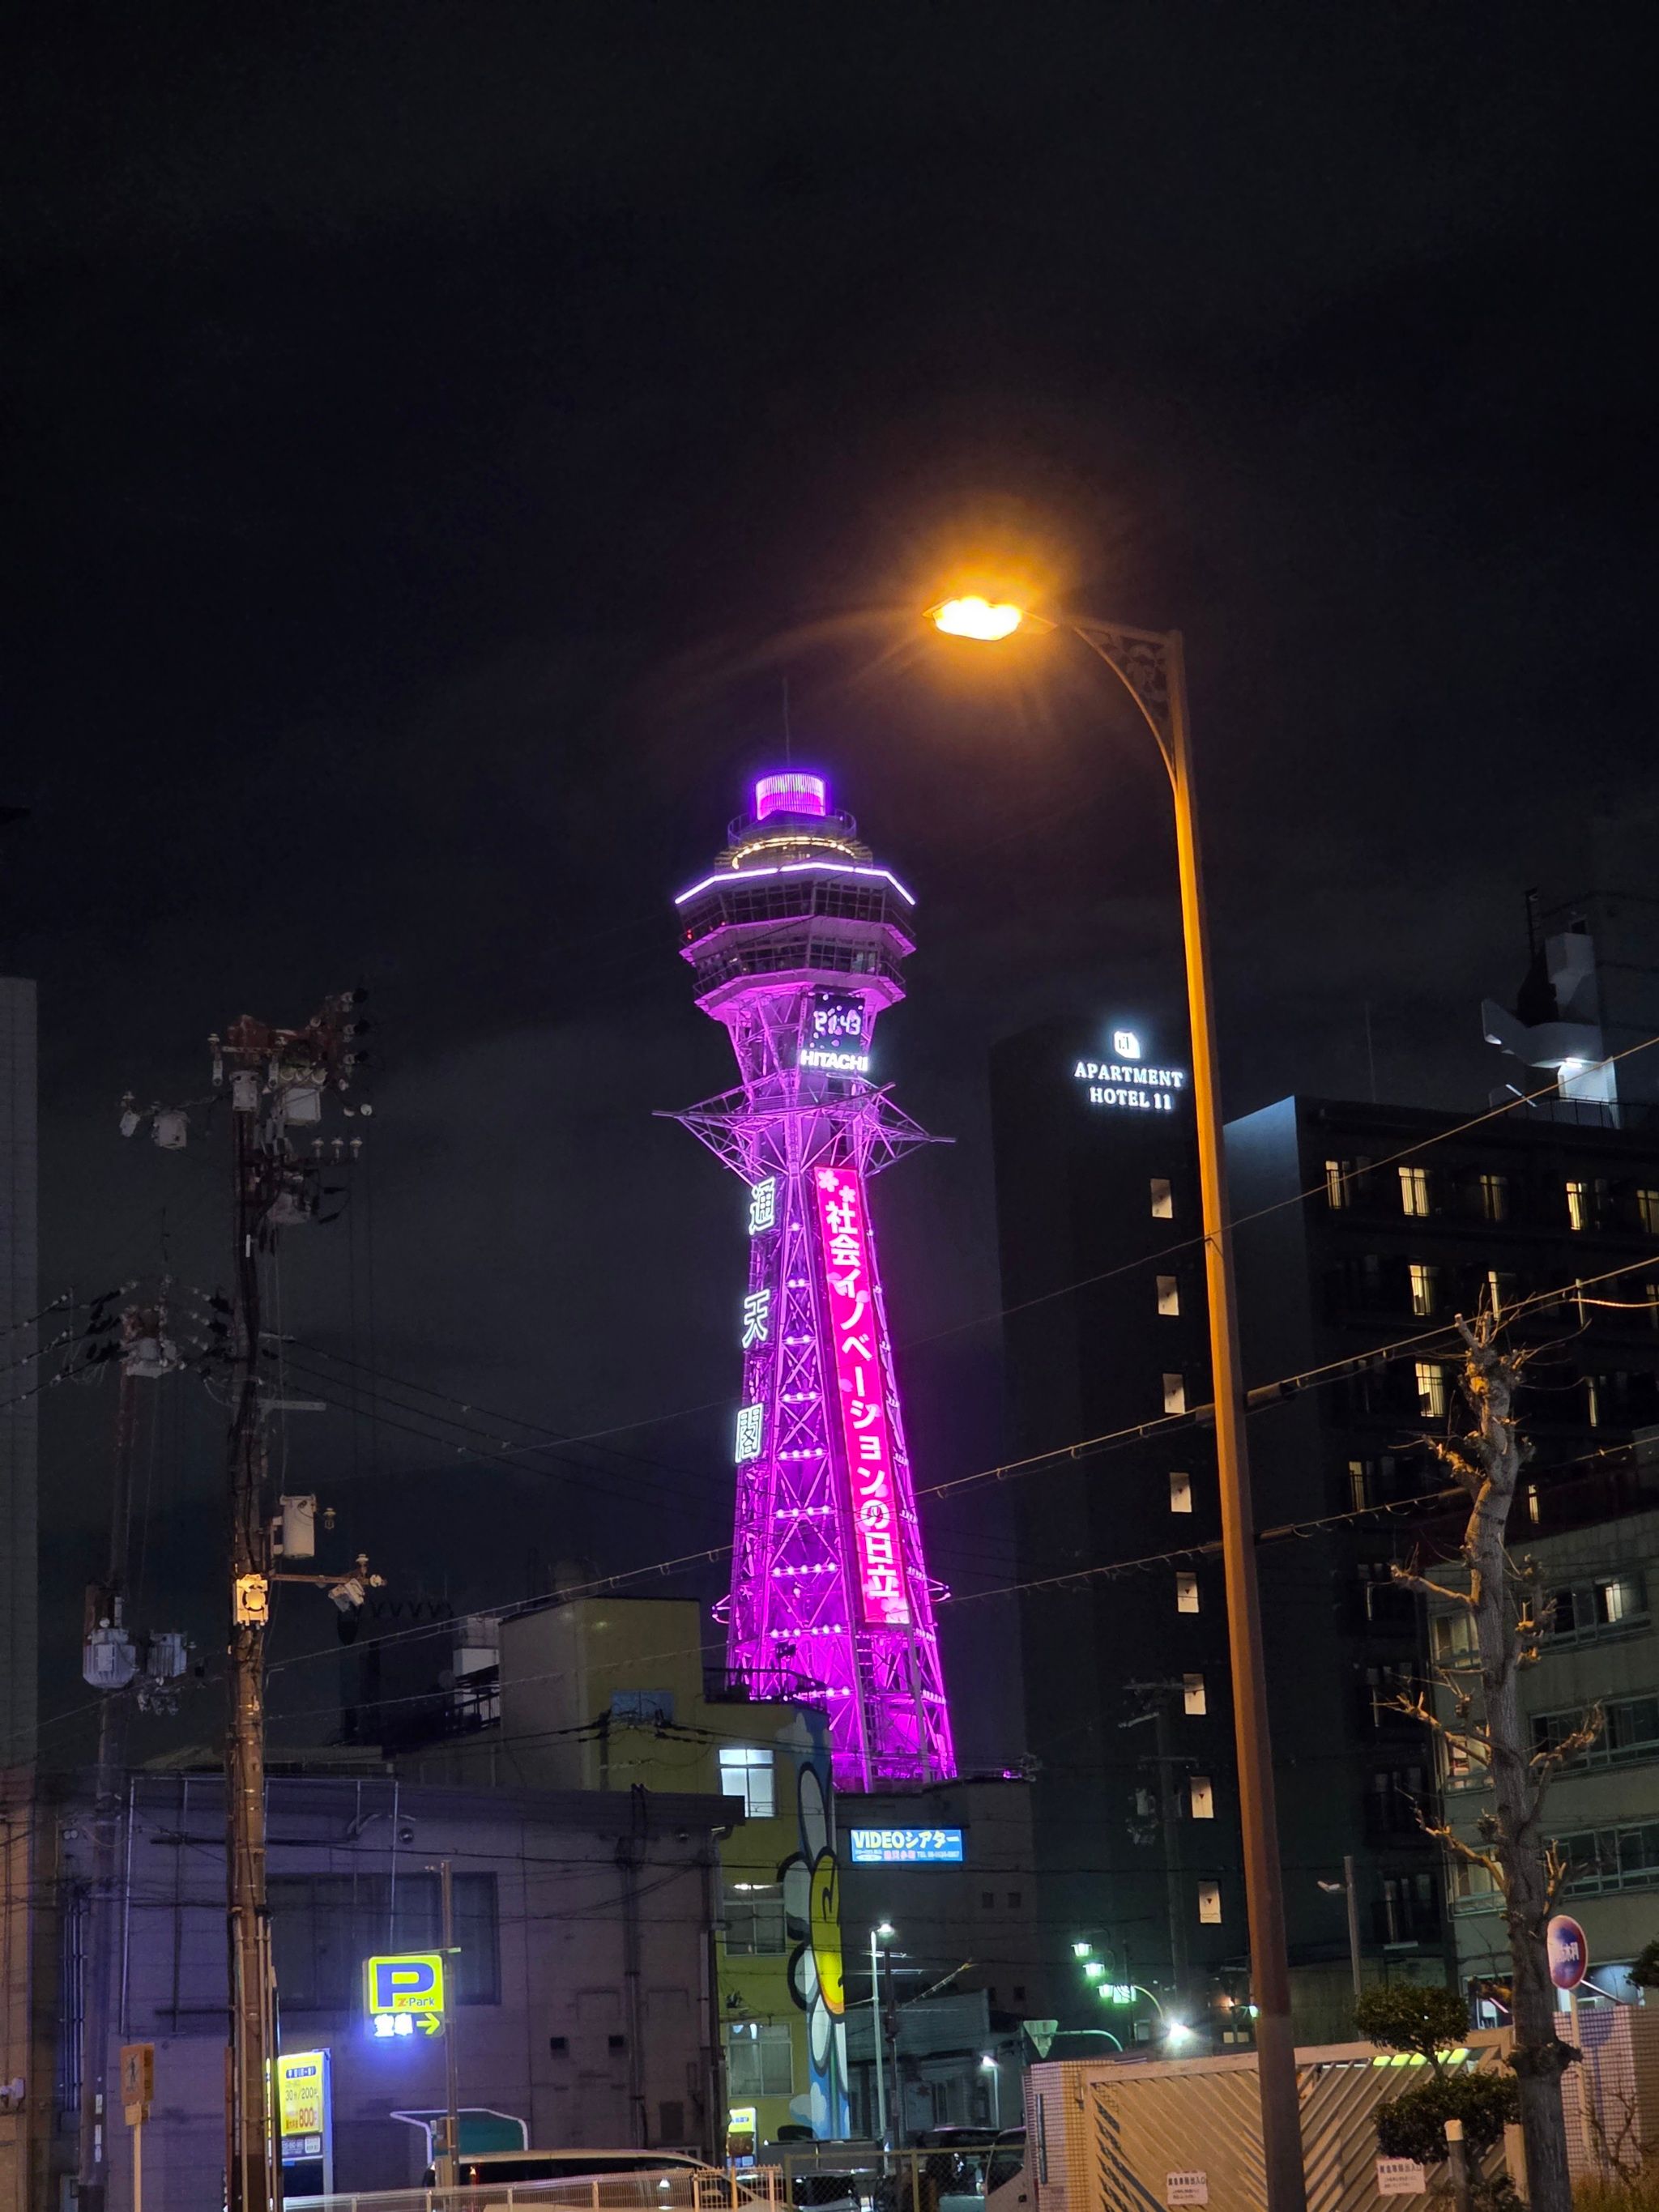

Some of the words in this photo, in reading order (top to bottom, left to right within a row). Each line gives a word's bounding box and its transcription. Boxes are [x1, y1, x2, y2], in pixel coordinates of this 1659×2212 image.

[800, 1050, 868, 1071] HITACHI
[1074, 1062, 1183, 1087] APARTMENT
[1090, 1087, 1150, 1108] HOTEL
[1154, 1093, 1172, 1110] 11
[825, 1200, 900, 1599] 社会イノベーションの日立
[852, 1831, 960, 1849] VIDEOシアター
[377, 1963, 434, 2007] P
